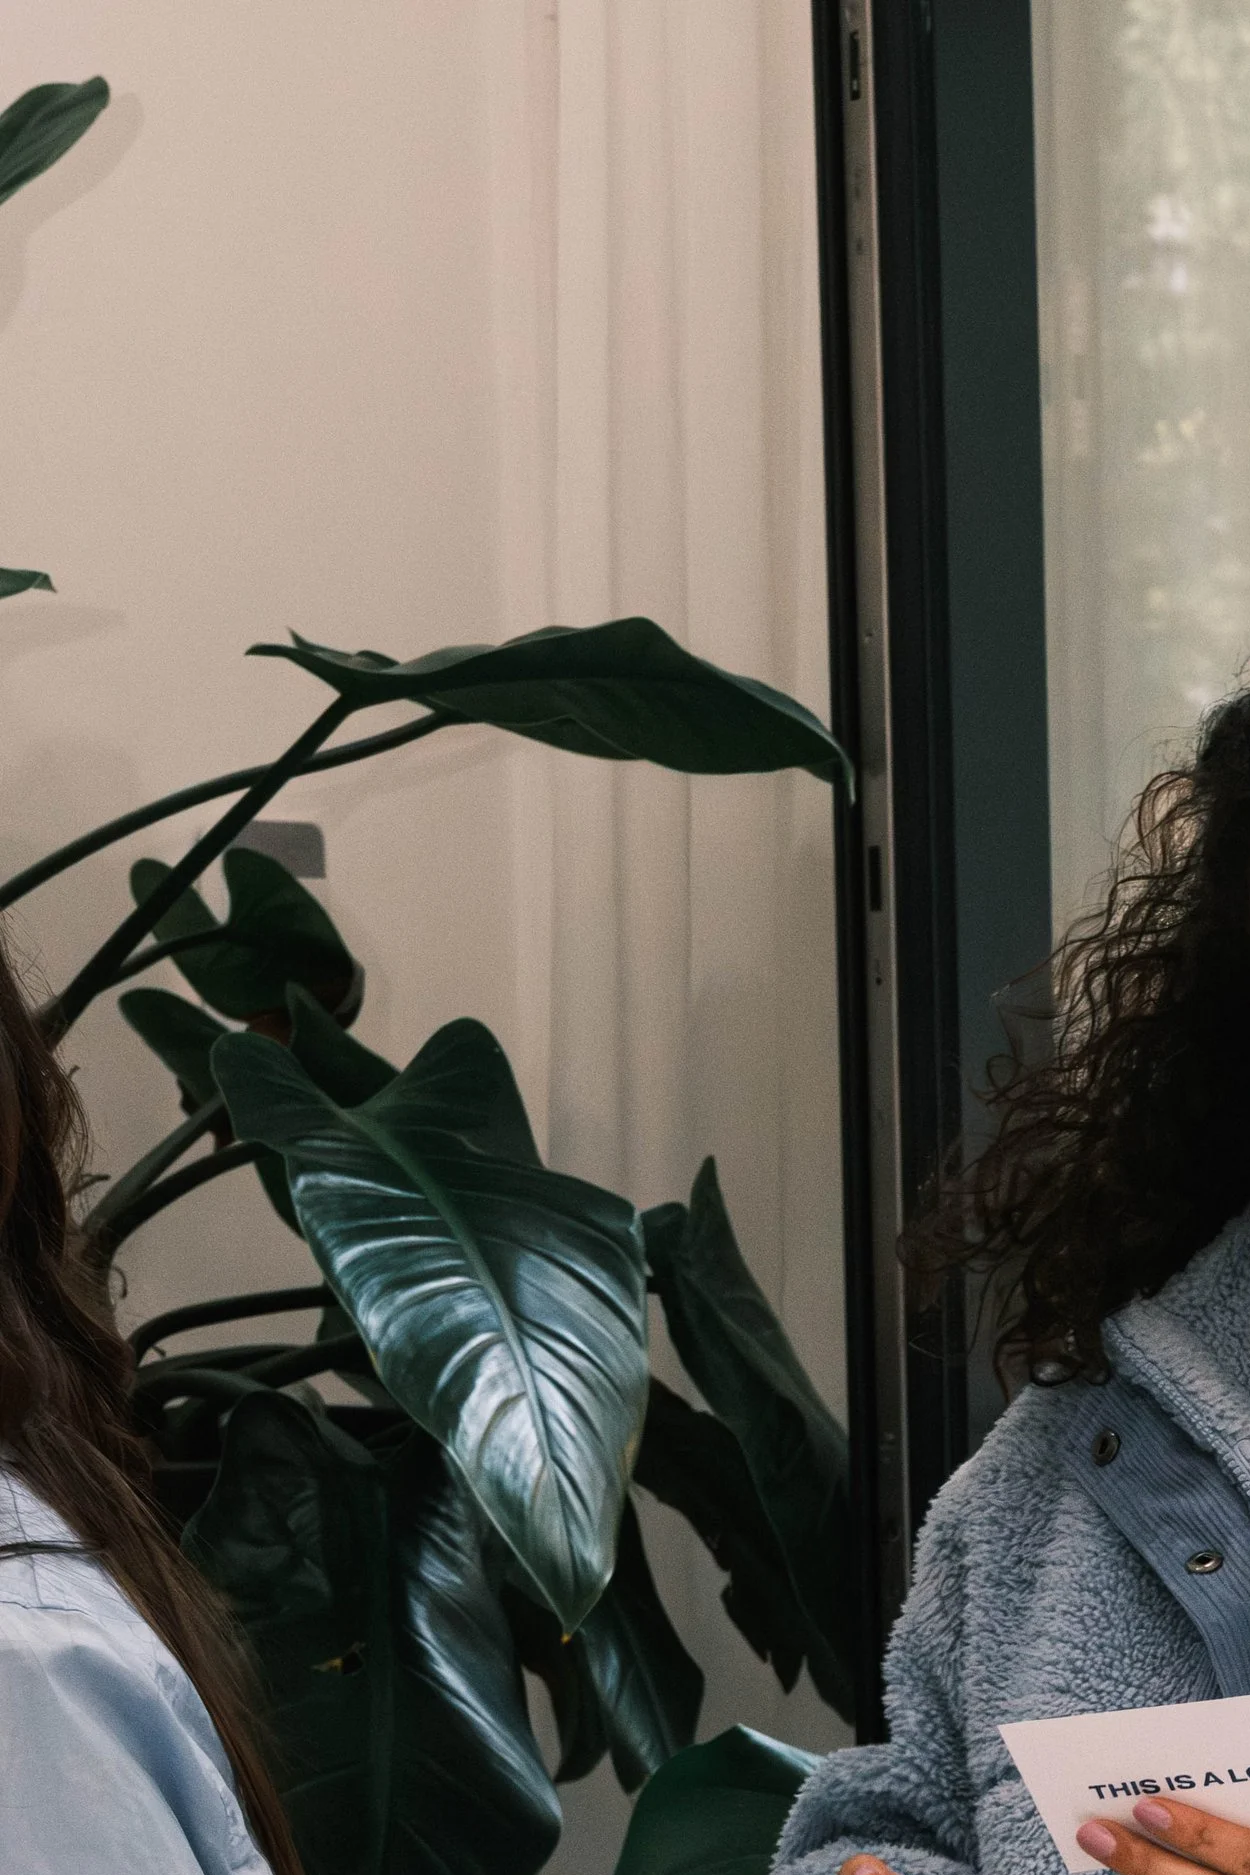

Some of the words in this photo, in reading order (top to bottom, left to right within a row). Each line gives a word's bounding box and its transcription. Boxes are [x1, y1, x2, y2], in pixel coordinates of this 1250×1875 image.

[1088, 1779, 1161, 1800] THIS
[1165, 1774, 1196, 1791] IS
[1203, 1771, 1224, 1787] A
